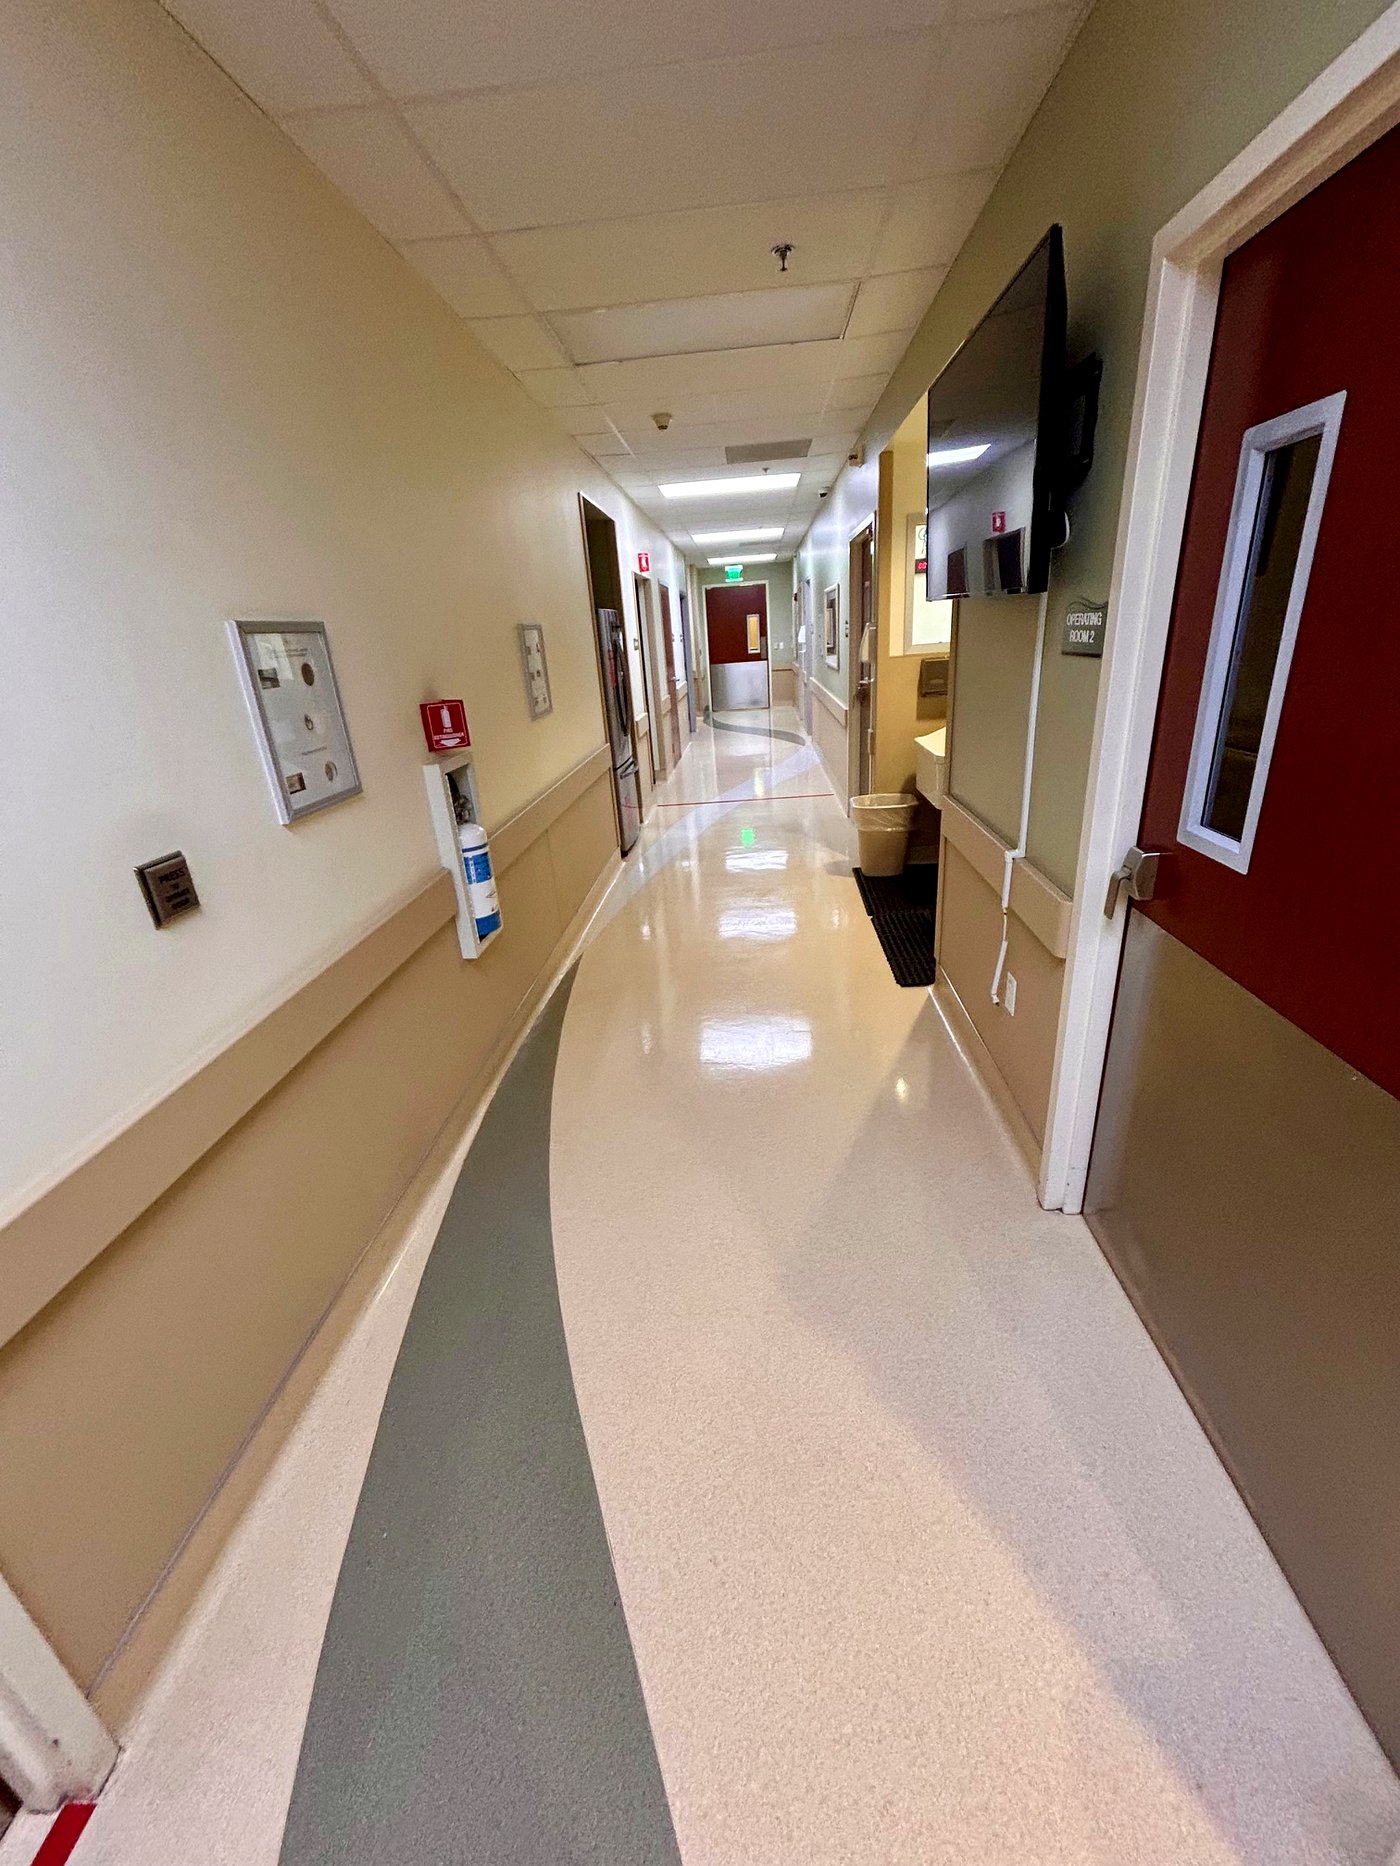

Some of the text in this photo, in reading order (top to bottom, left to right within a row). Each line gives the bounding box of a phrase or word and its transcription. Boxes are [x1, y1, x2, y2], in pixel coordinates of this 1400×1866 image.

[1066, 611, 1102, 626] OPERATING
[1069, 629, 1095, 643] ROOM 2
[159, 868, 186, 884] PRESS
